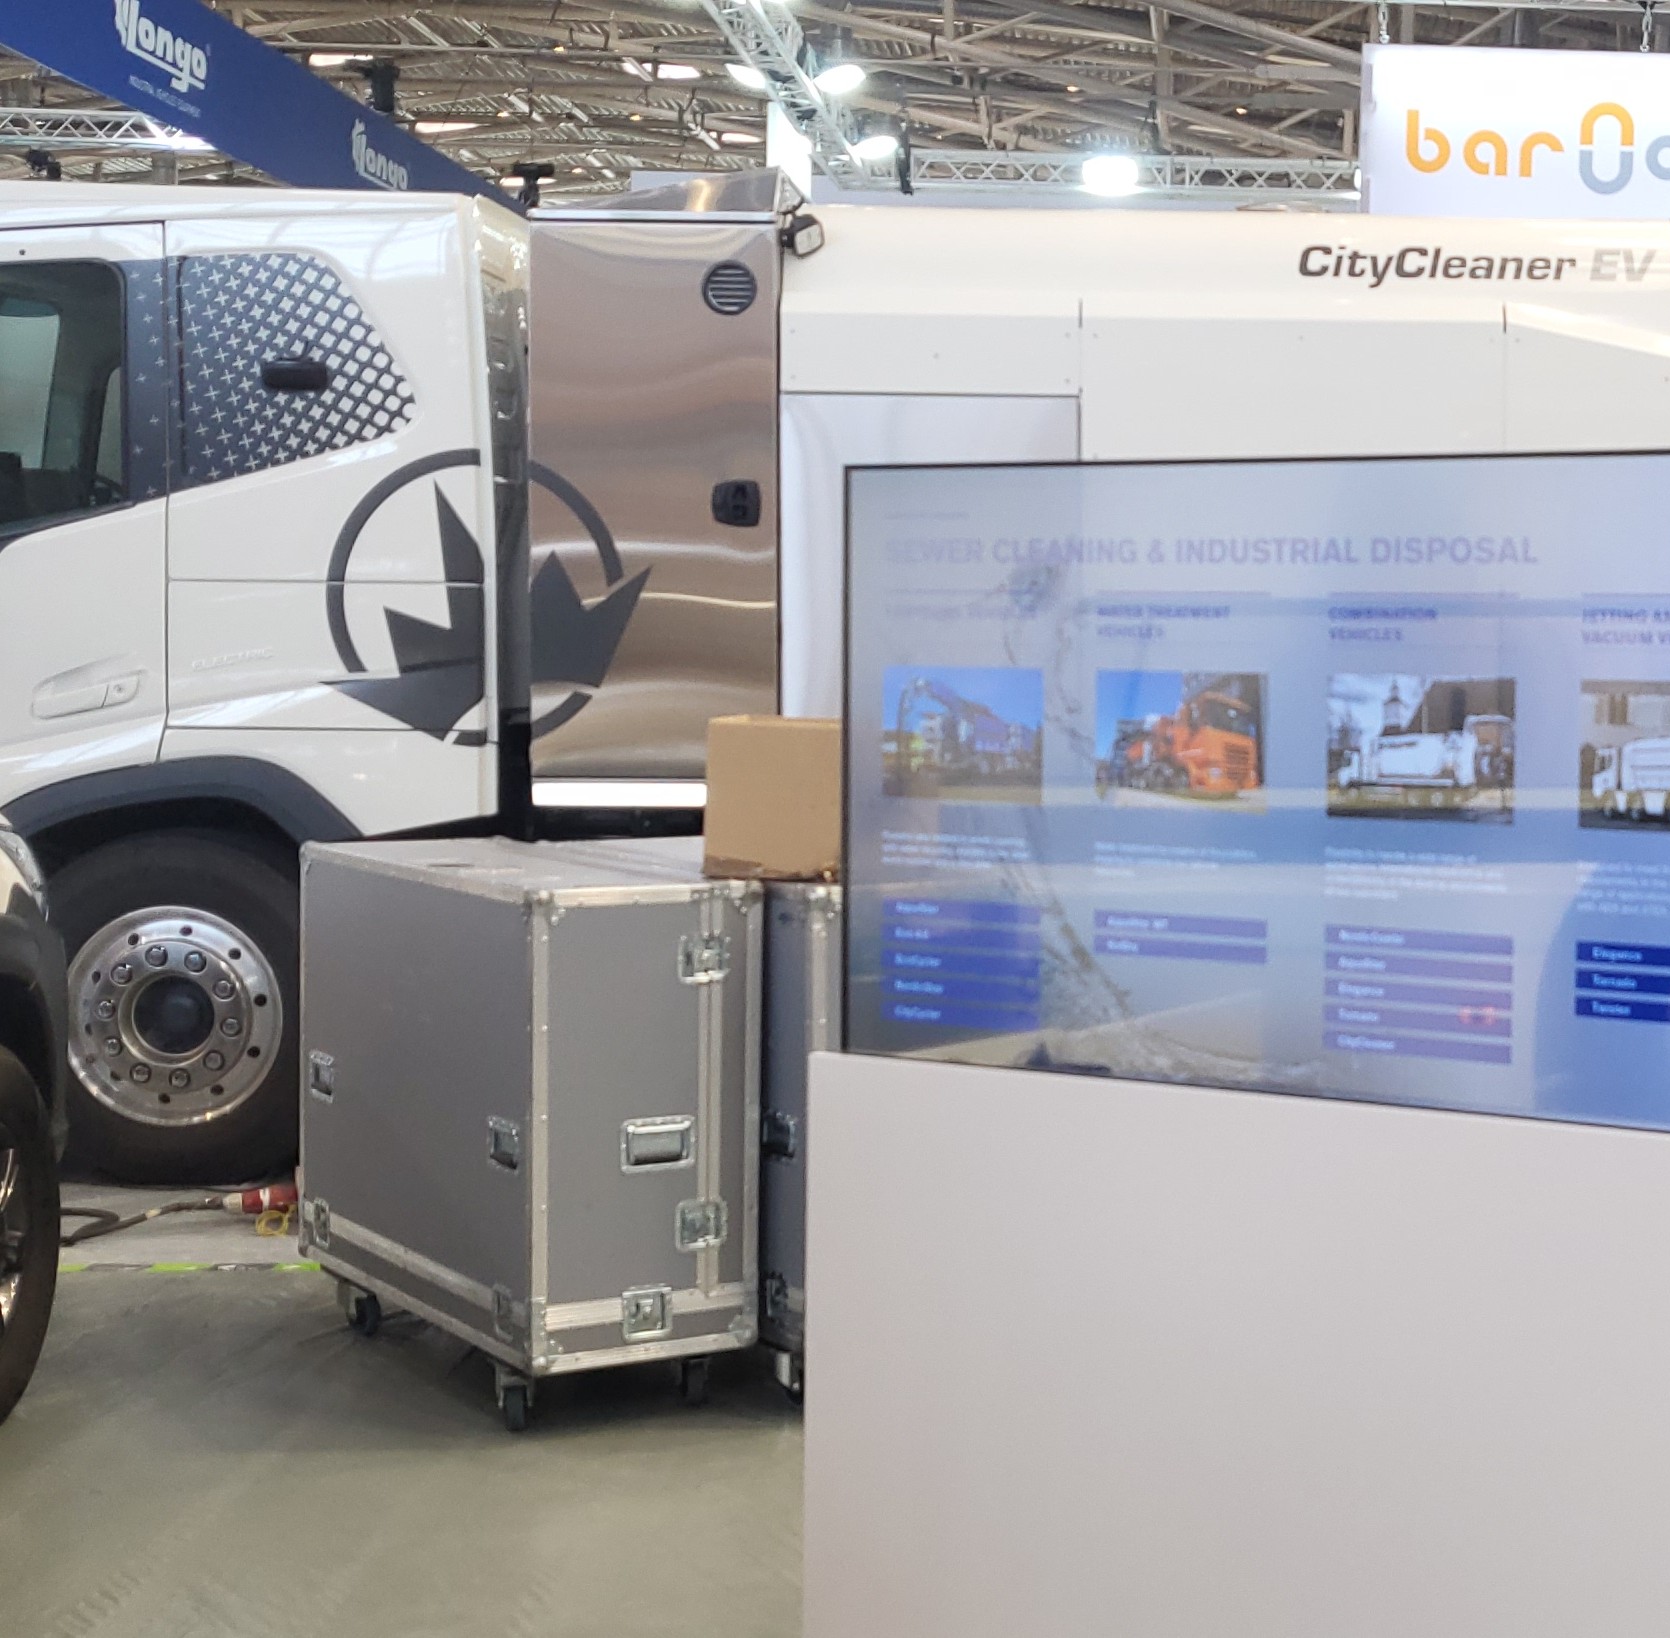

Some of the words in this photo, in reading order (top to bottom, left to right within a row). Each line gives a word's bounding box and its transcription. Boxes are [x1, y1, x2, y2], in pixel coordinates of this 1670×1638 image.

[1299, 246, 1576, 289] CityCleaner
[1590, 249, 1657, 281] EV
[885, 537, 982, 564] SEWER
[992, 537, 1137, 564] CLEANING
[1147, 539, 1165, 563] &
[1176, 537, 1358, 564] INDUSTRIAL
[1370, 536, 1537, 564] DISPOSAL
[1328, 627, 1404, 640] VEHICLES
[1581, 630, 1653, 645] VACUUM
